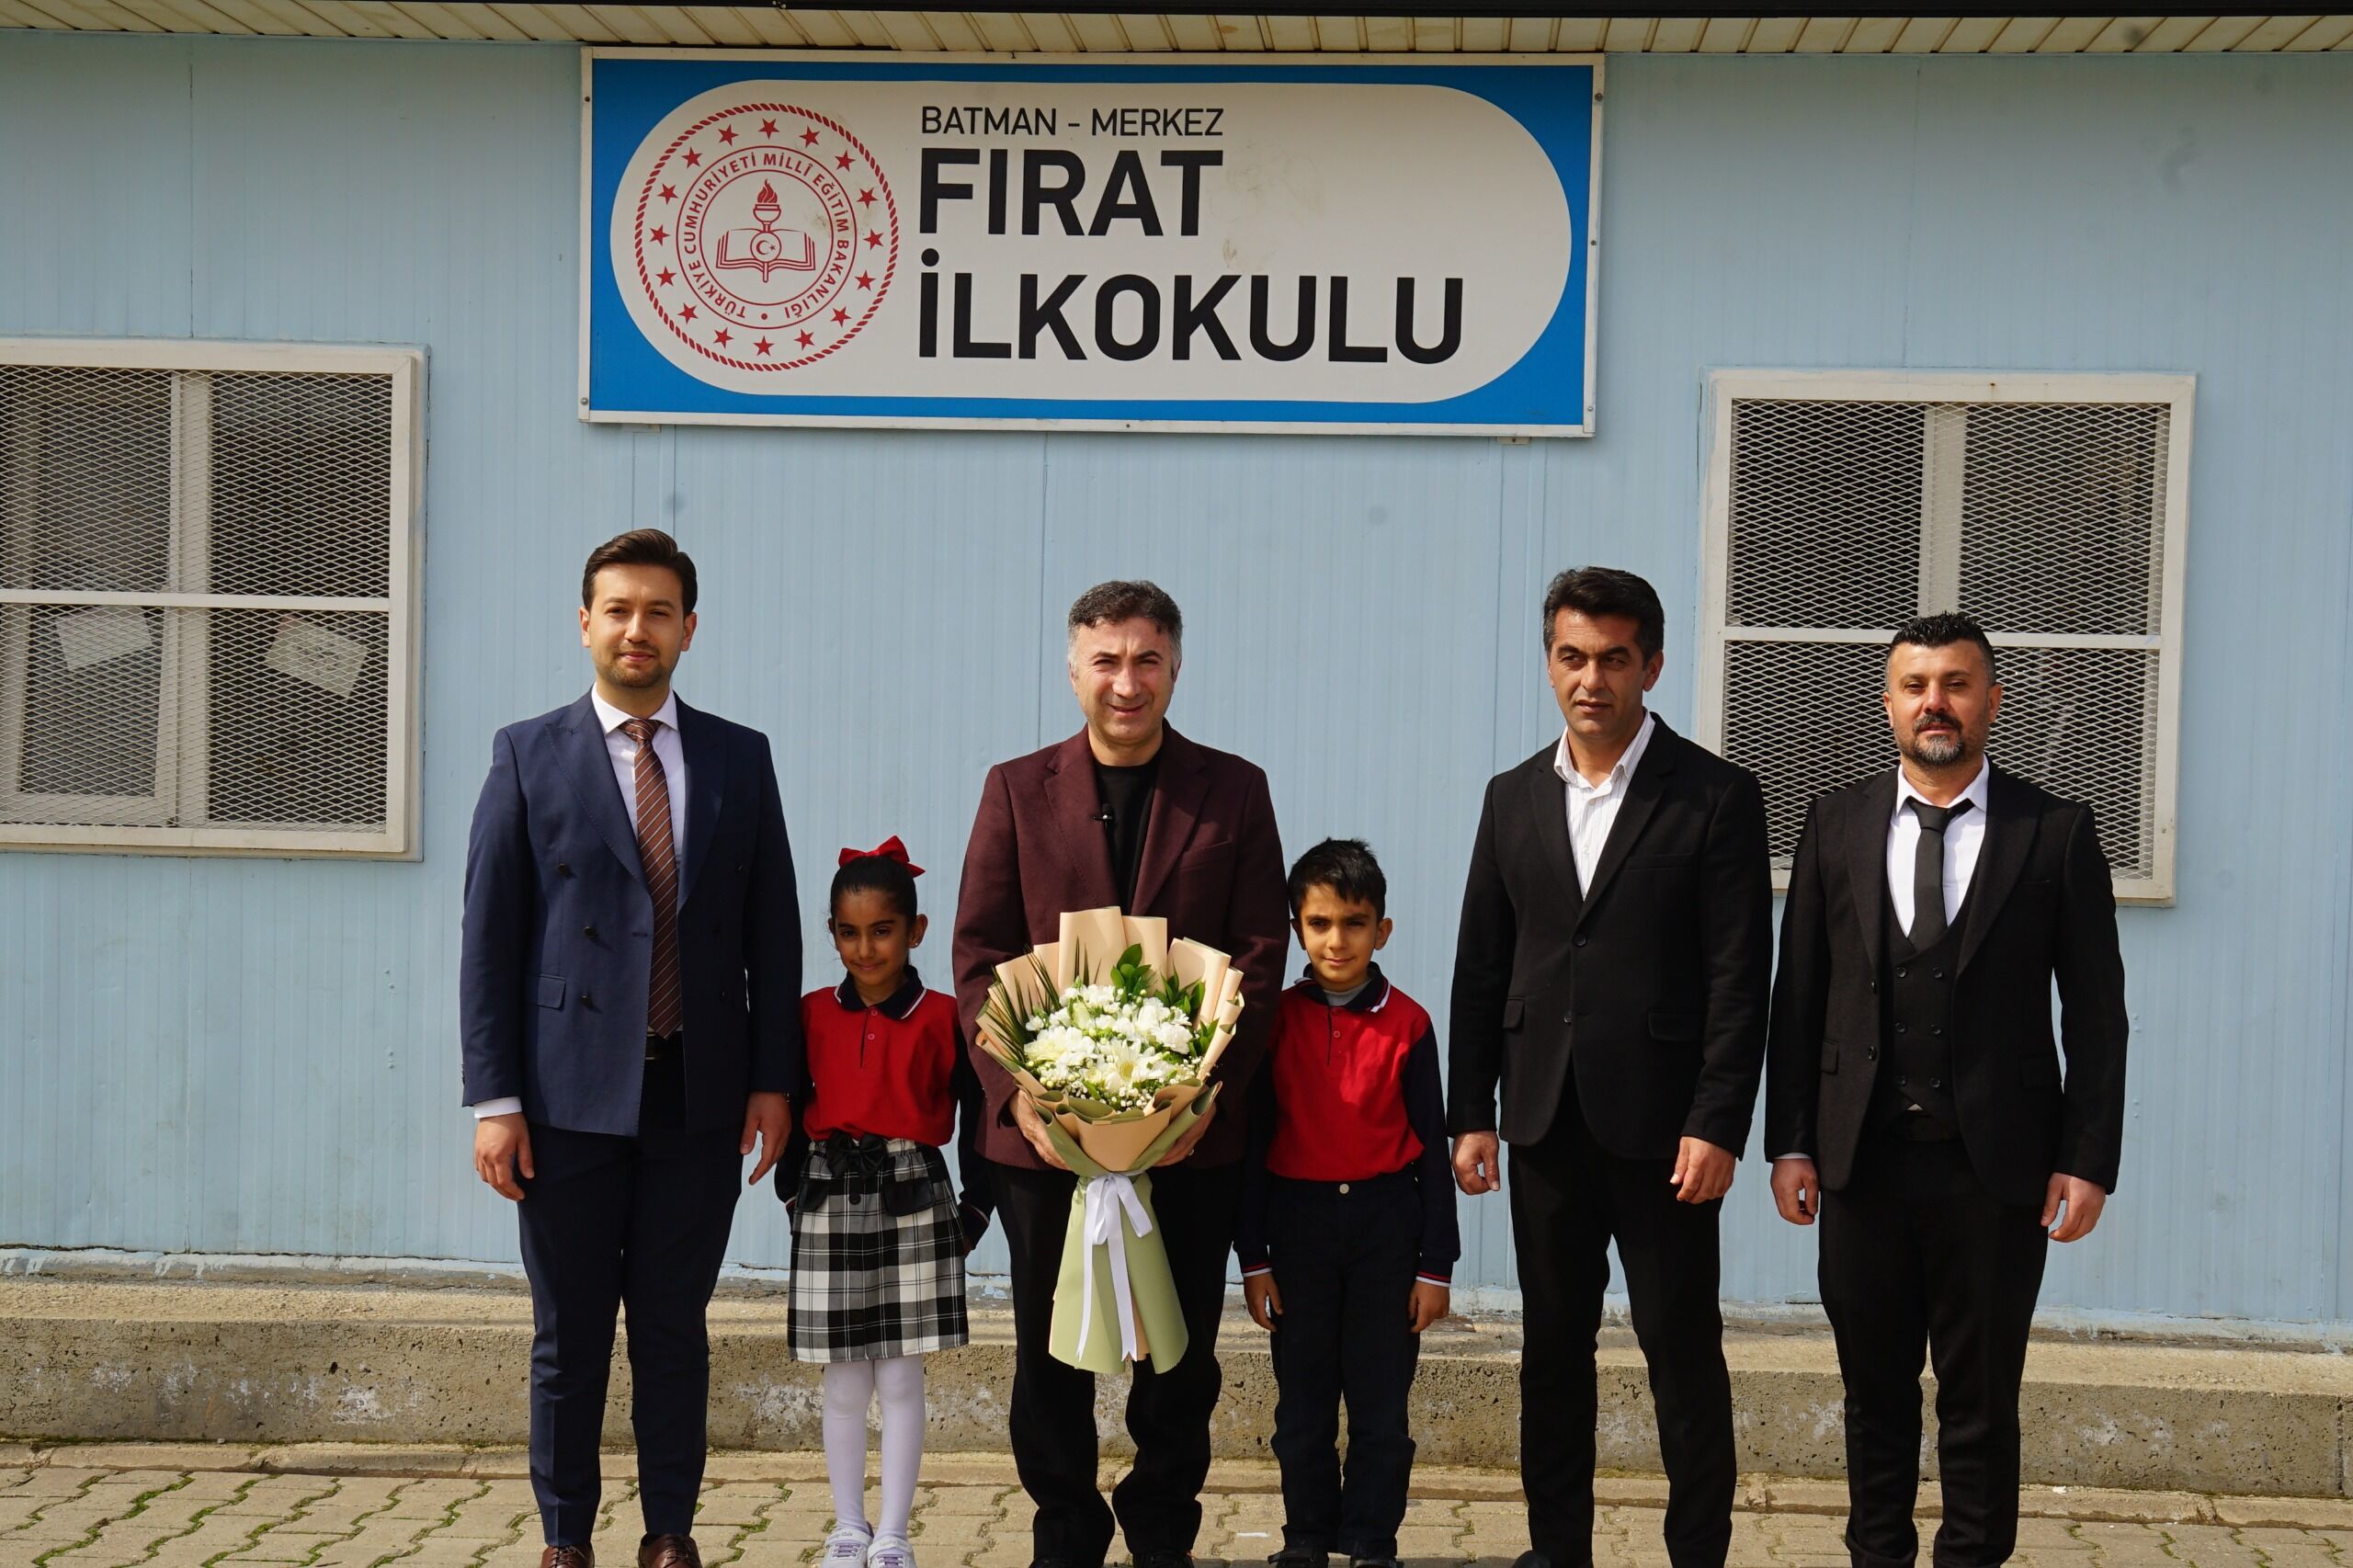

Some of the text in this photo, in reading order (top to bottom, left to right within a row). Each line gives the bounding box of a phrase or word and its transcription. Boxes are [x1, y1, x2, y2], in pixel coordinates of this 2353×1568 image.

[921, 106, 1057, 136] BATMAN
[1091, 108, 1224, 137] MERKEZ
[682, 151, 757, 256] CUMHURİYETİ
[812, 173, 850, 233] EĞİTİM
[919, 147, 1223, 236] FIRAT
[687, 259, 746, 319] TÜRKİYE
[782, 237, 850, 320] BAKANLIĞI
[919, 247, 1463, 365] İLKOKULU
